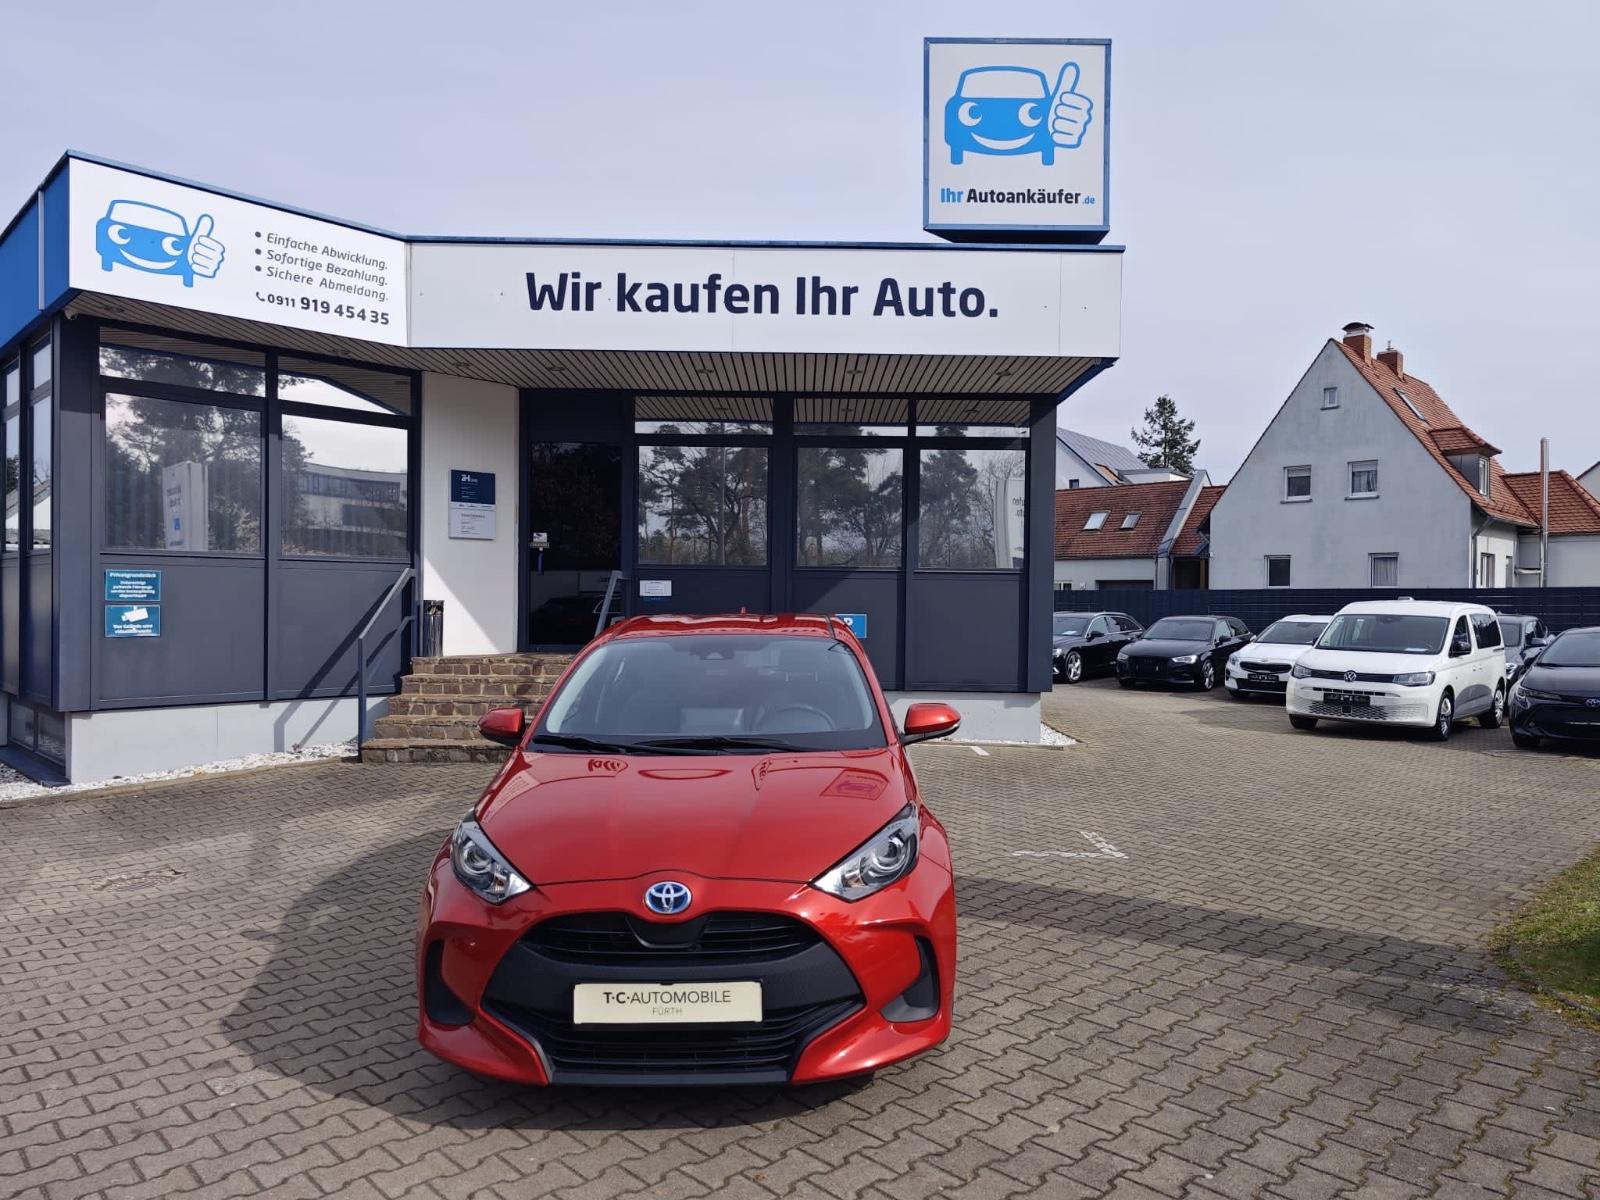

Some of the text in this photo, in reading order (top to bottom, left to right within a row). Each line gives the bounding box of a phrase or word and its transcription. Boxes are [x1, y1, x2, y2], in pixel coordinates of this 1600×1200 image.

[940, 187, 963, 203] Ihr
[267, 232, 388, 271] Einfache Abwicklung.
[267, 249, 388, 287] Sofortige Bezahlung.
[267, 266, 389, 302] Sichere Abmeldung.
[525, 271, 998, 318] Wir kaufen Ihr Auto.
[267, 293, 296, 308] 0911
[300, 296, 331, 314] 919
